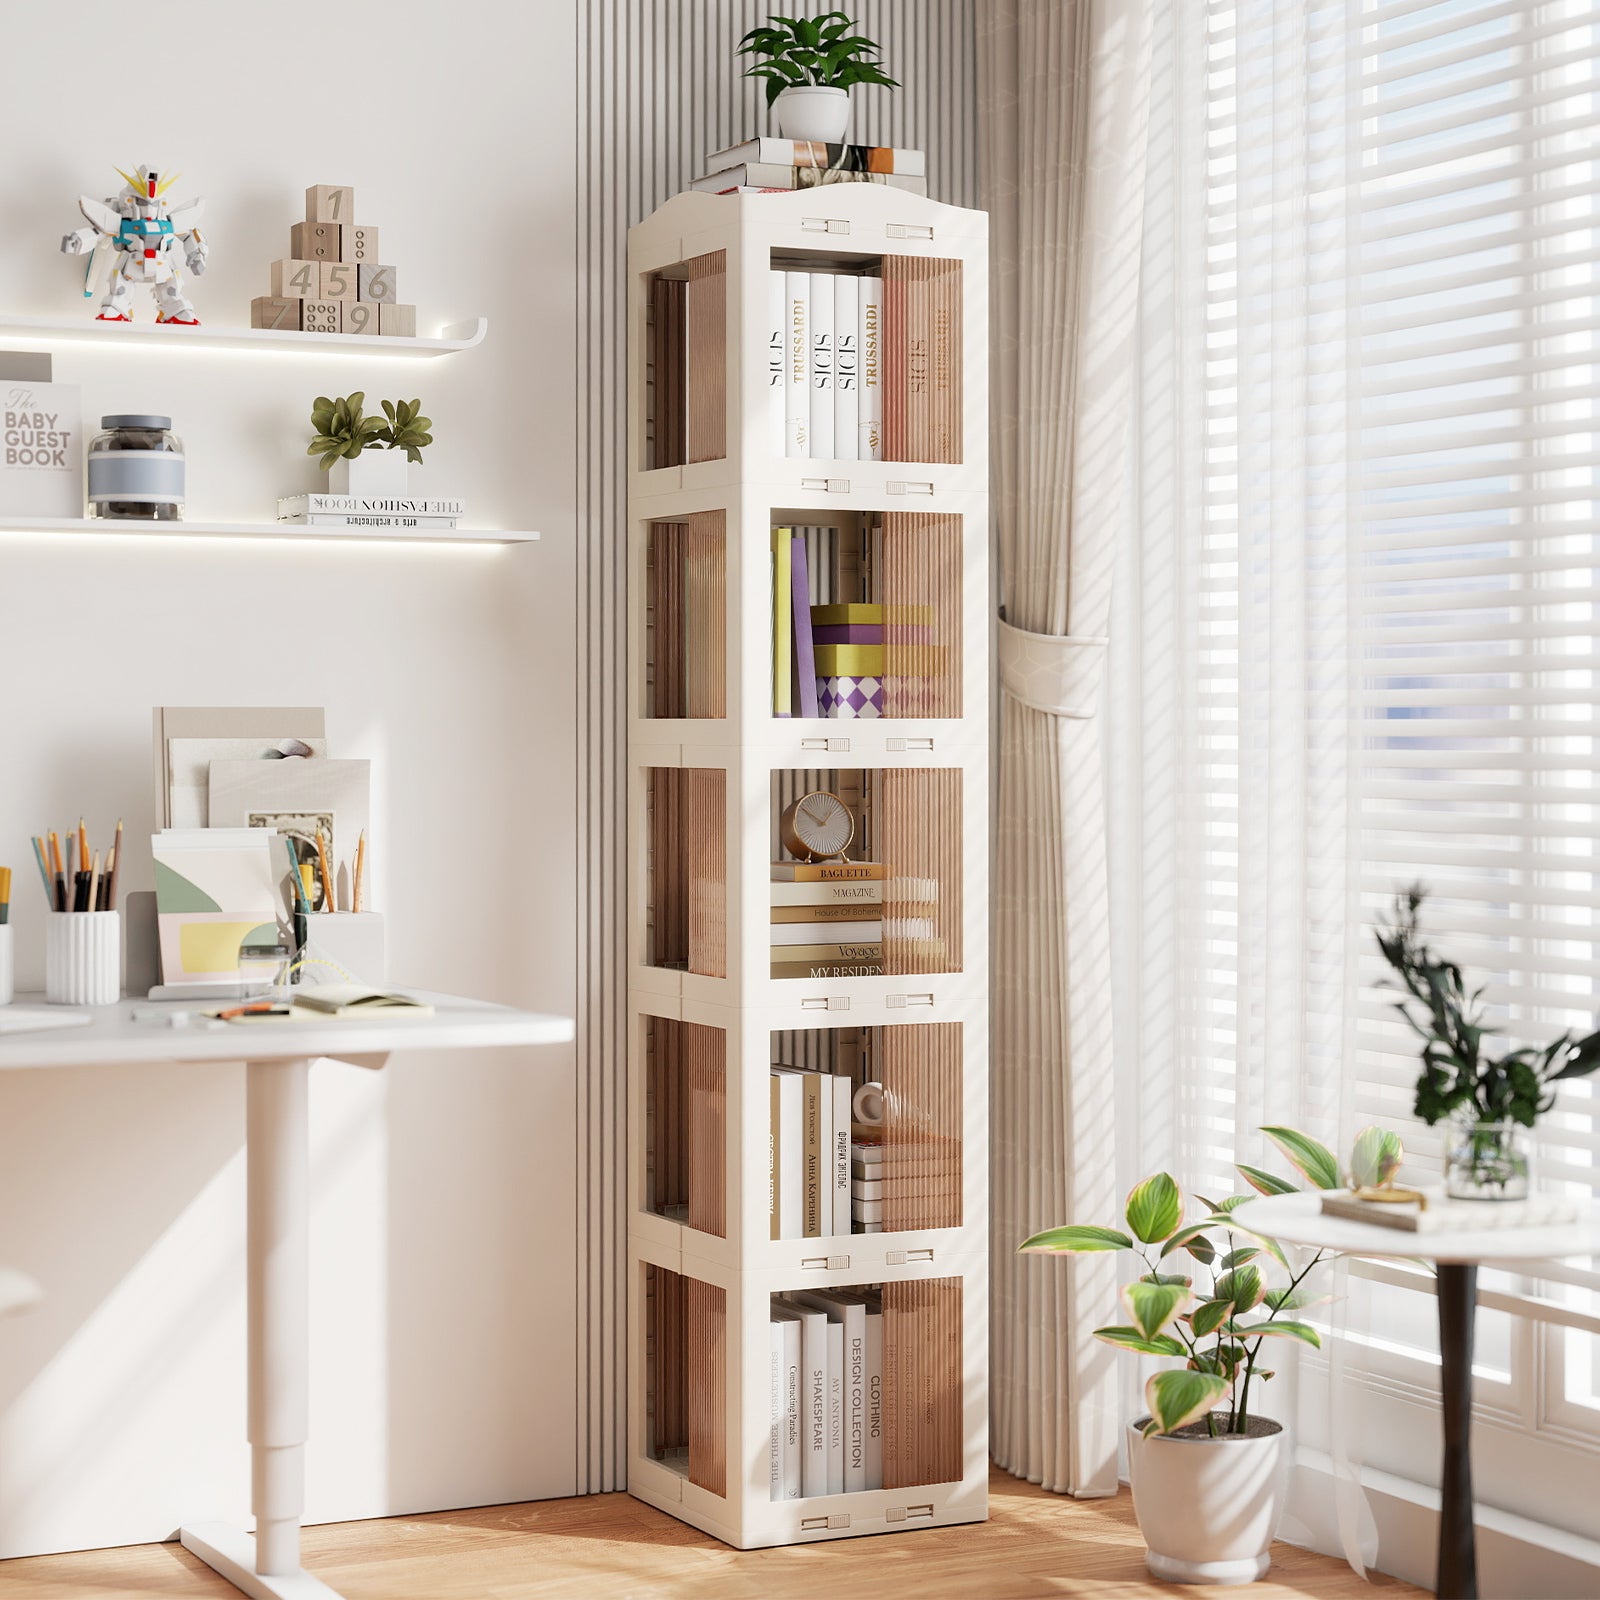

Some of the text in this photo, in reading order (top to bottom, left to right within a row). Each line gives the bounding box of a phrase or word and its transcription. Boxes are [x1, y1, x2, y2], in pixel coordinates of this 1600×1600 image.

[327, 189, 344, 220] 1
[289, 264, 389, 299] 4 5 6
[270, 301, 370, 335] 7 9
[793, 299, 805, 384] TRUSSARDI
[866, 303, 878, 388] TRUSSARDI
[770, 330, 783, 387] SICIS
[814, 333, 832, 390] SICIS
[837, 334, 856, 391] SICIS
[4, 388, 38, 409] The
[5, 411, 58, 430] BABY
[4, 430, 71, 449] GUEST
[6, 448, 65, 466] BOOK
[314, 497, 463, 513] THE FASHION BOOK
[346, 517, 391, 526] architecture
[402, 518, 417, 527] arts
[820, 868, 872, 878] BAGUETTE
[833, 888, 875, 898] MAGAZINE
[814, 909, 839, 917] House
[841, 908, 851, 916] Of
[838, 945, 879, 959] Voyage
[809, 967, 830, 978] MY
[788, 1365, 797, 1413] Constructing
[832, 1378, 839, 1394] MY
[813, 1370, 823, 1451] SHAKESPEARE
[852, 1338, 861, 1469] DESIGN COLLECTION
[870, 1375, 880, 1438] CLOTHING
